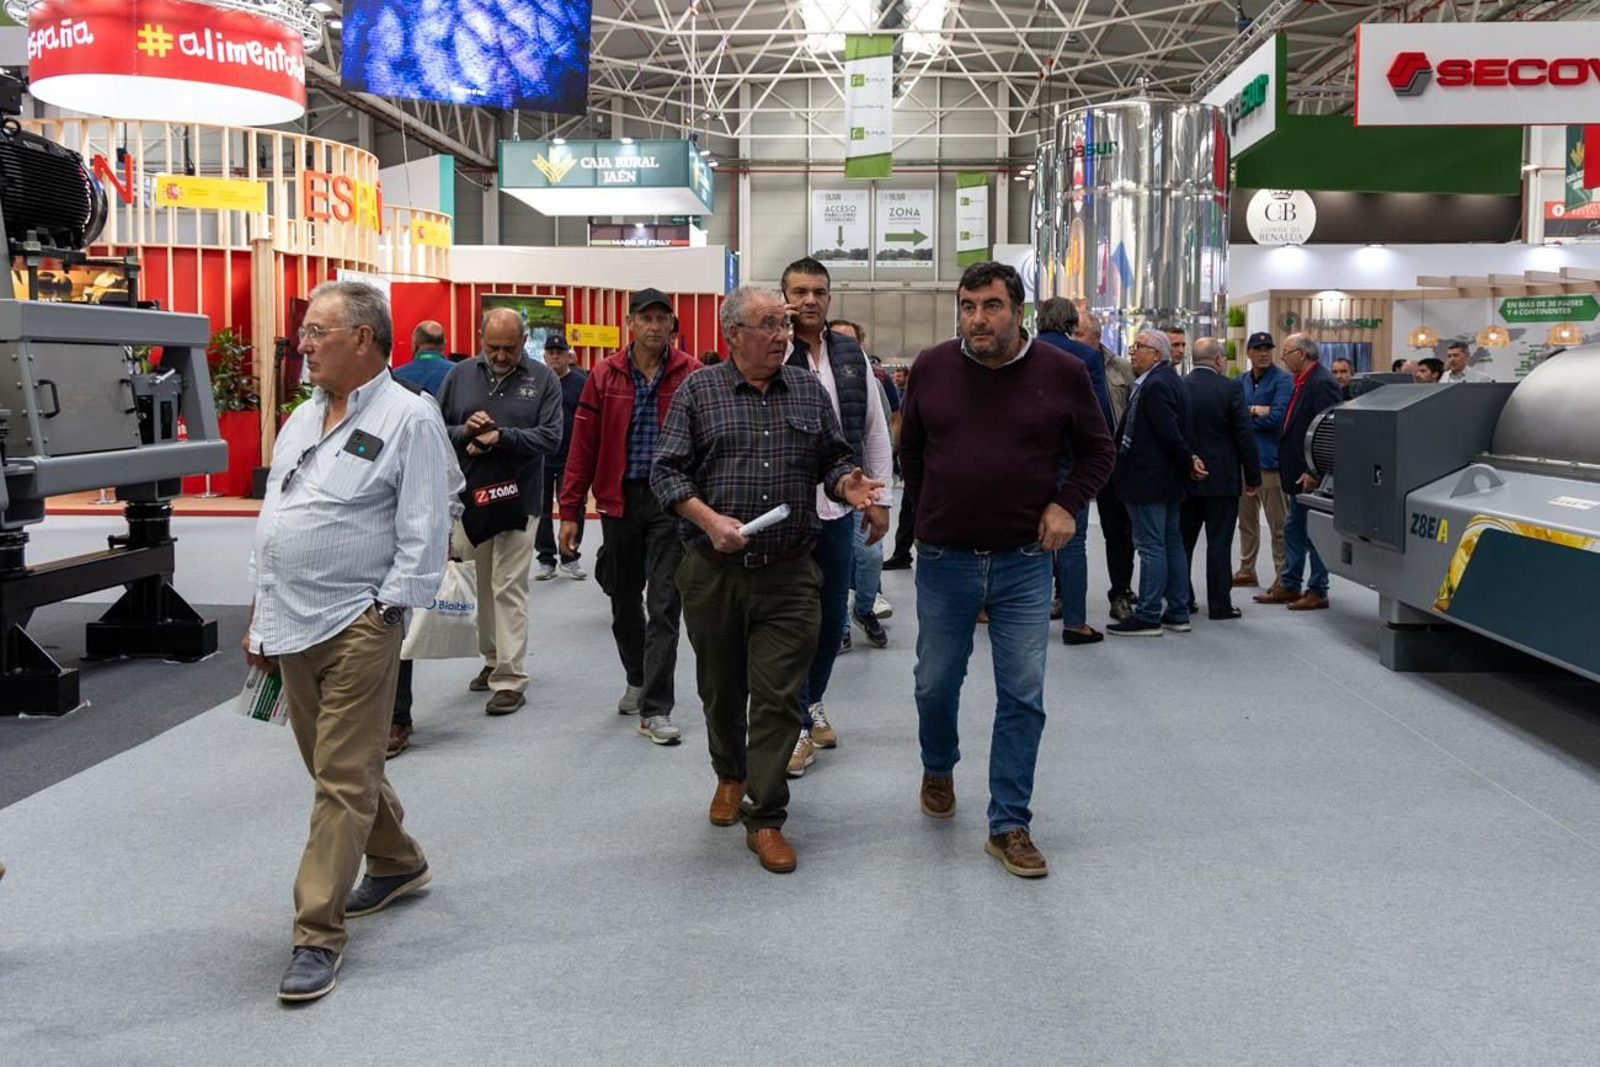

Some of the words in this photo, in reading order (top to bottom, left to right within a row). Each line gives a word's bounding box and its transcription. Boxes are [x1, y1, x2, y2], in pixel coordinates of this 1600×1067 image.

[28, 19, 94, 59] spaña
[614, 156, 659, 168] RURAL
[889, 207, 920, 217] ZONA
[1264, 202, 1297, 221] CB
